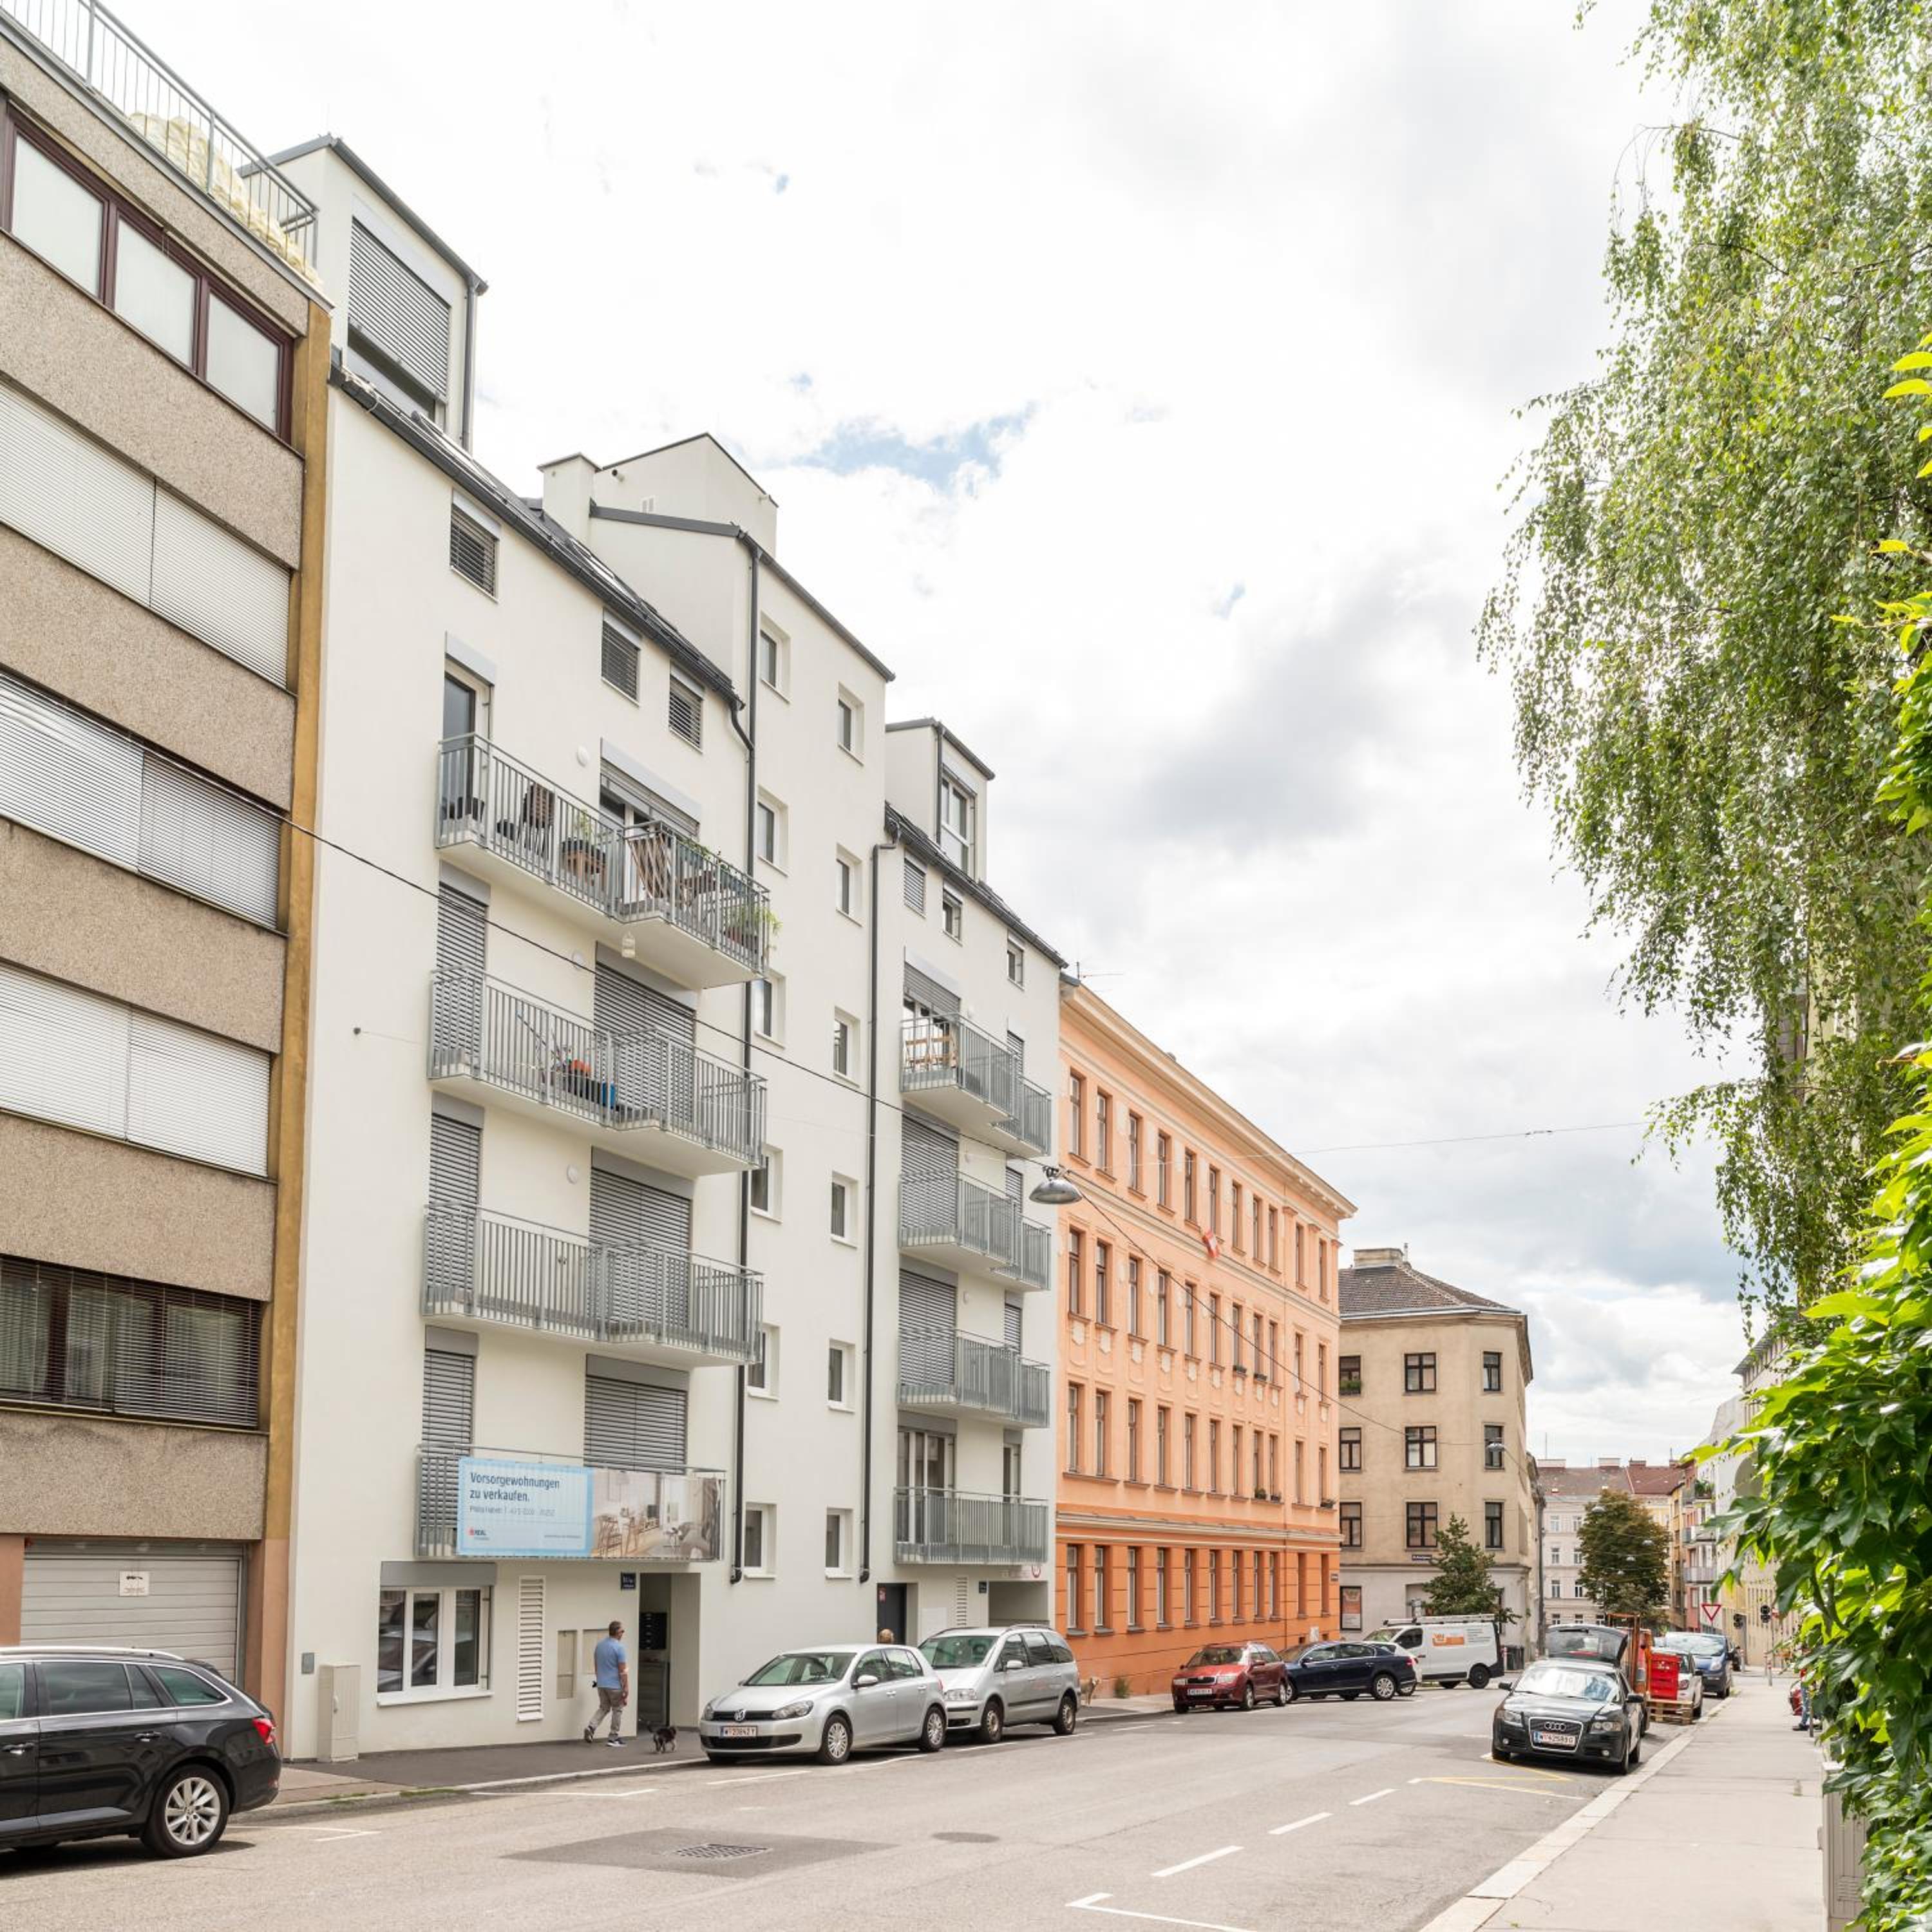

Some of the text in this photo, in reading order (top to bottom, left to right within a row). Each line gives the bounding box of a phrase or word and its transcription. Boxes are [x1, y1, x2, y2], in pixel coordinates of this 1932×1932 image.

[470, 1472, 560, 1490] Vorsorgewohnungen
[469, 1490, 530, 1502] zu verkaufen.
